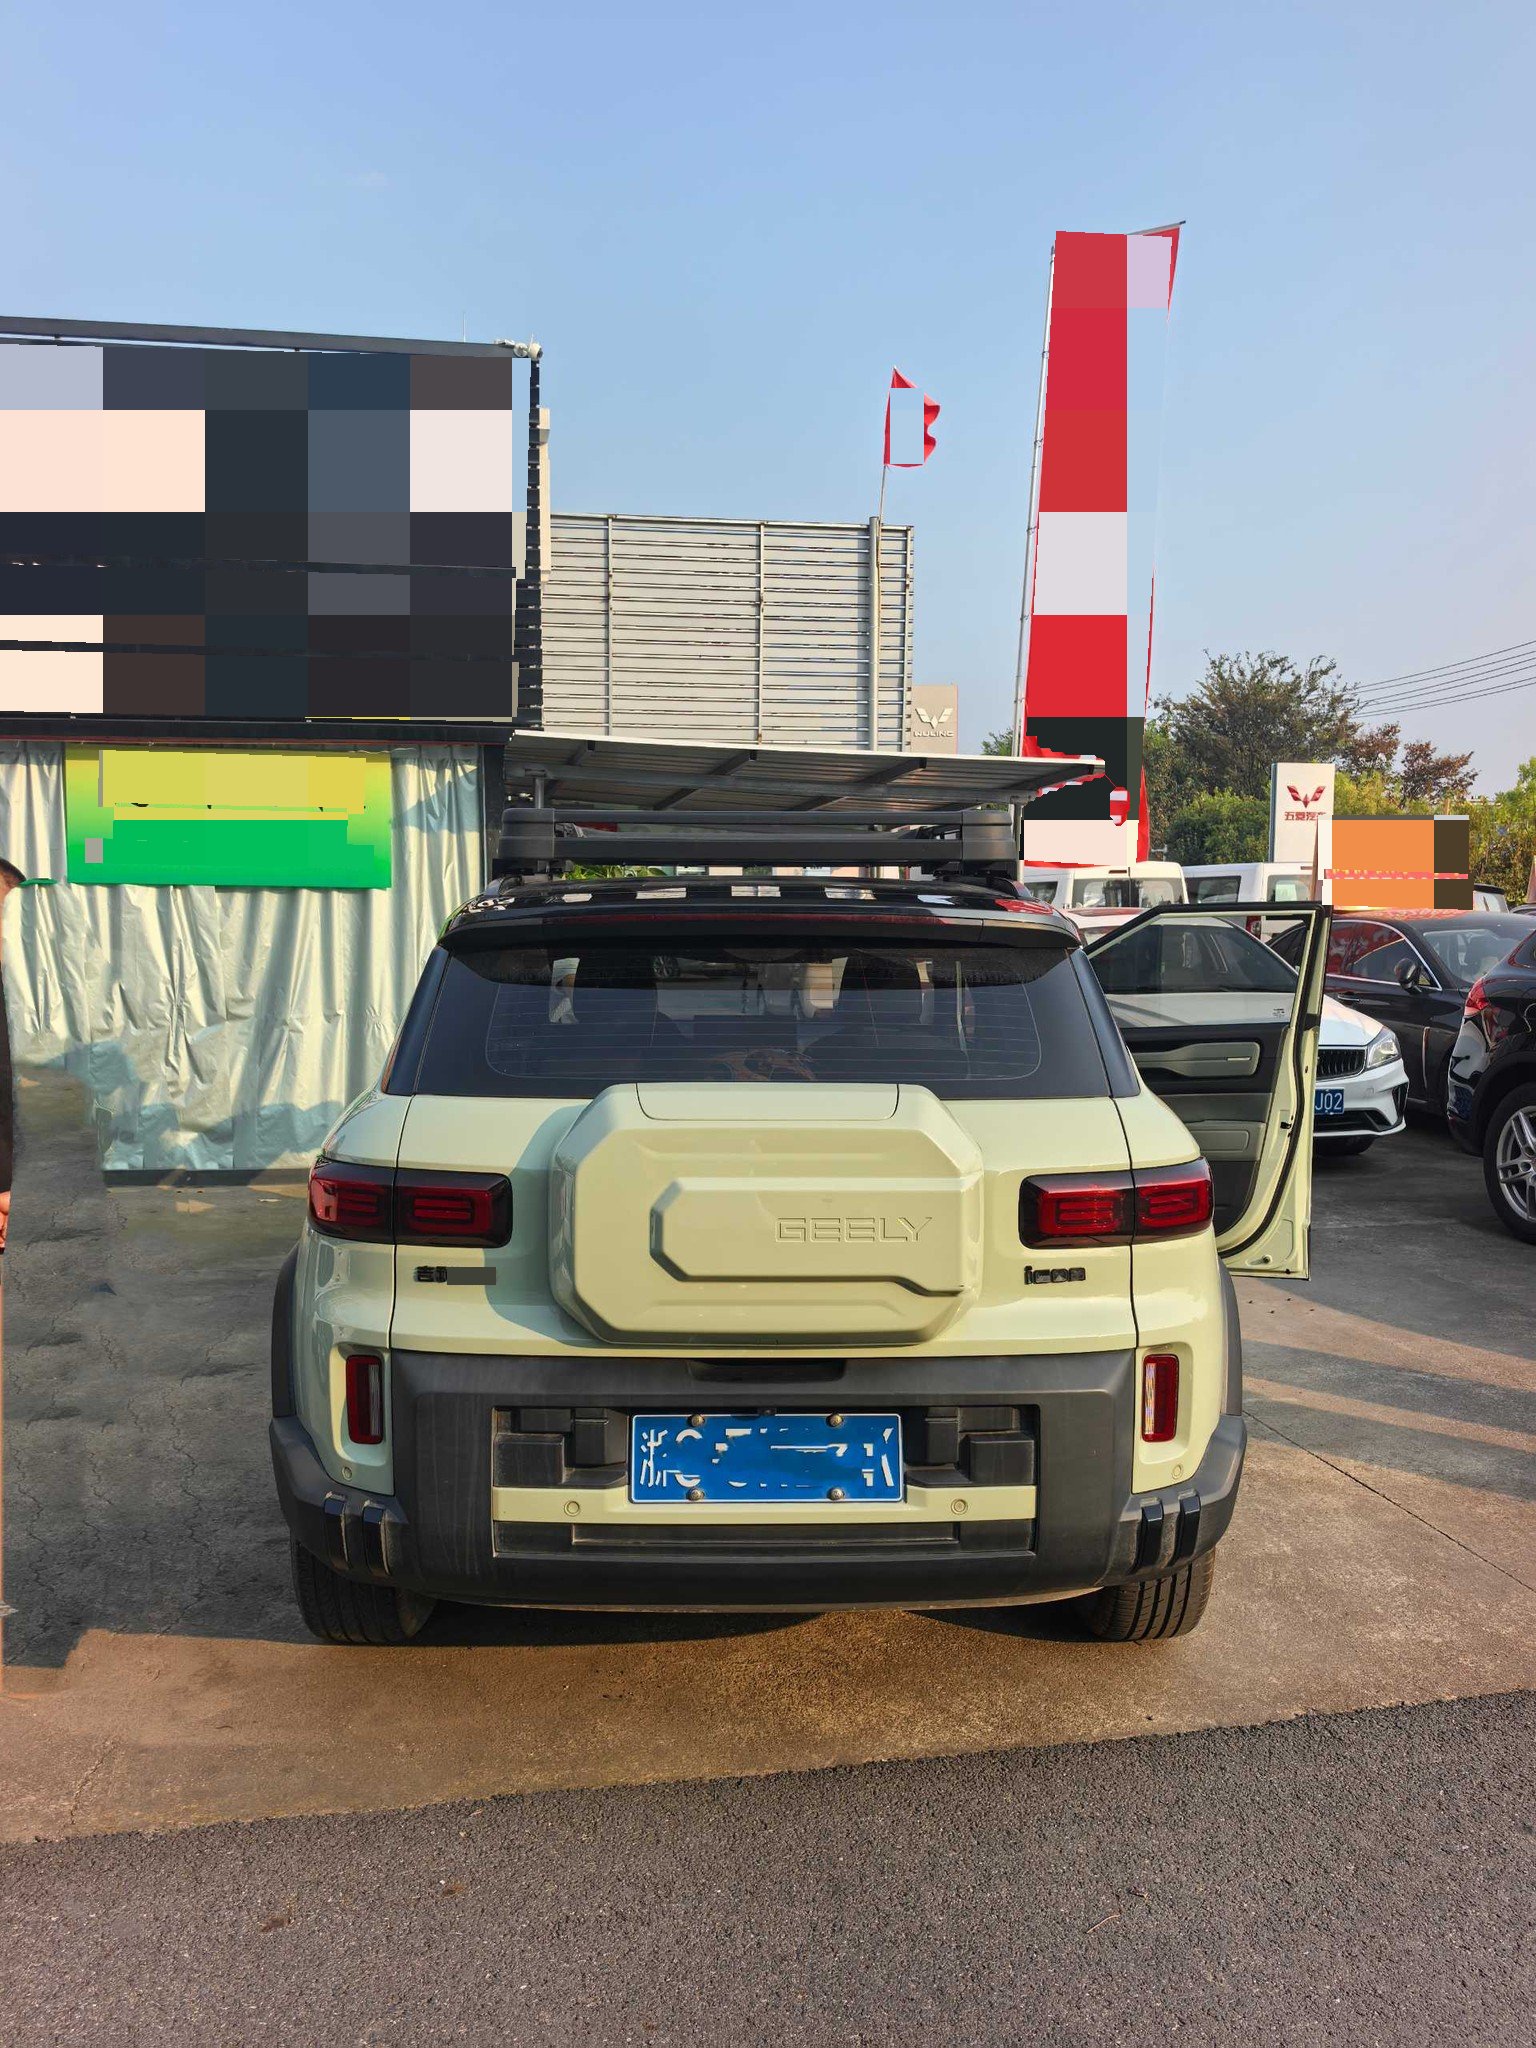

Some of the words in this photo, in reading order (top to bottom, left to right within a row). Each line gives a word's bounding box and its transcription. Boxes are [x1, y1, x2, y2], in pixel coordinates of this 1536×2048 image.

[1284, 811, 1327, 821] 五菱汽
[774, 1216, 933, 1243] GEELY
